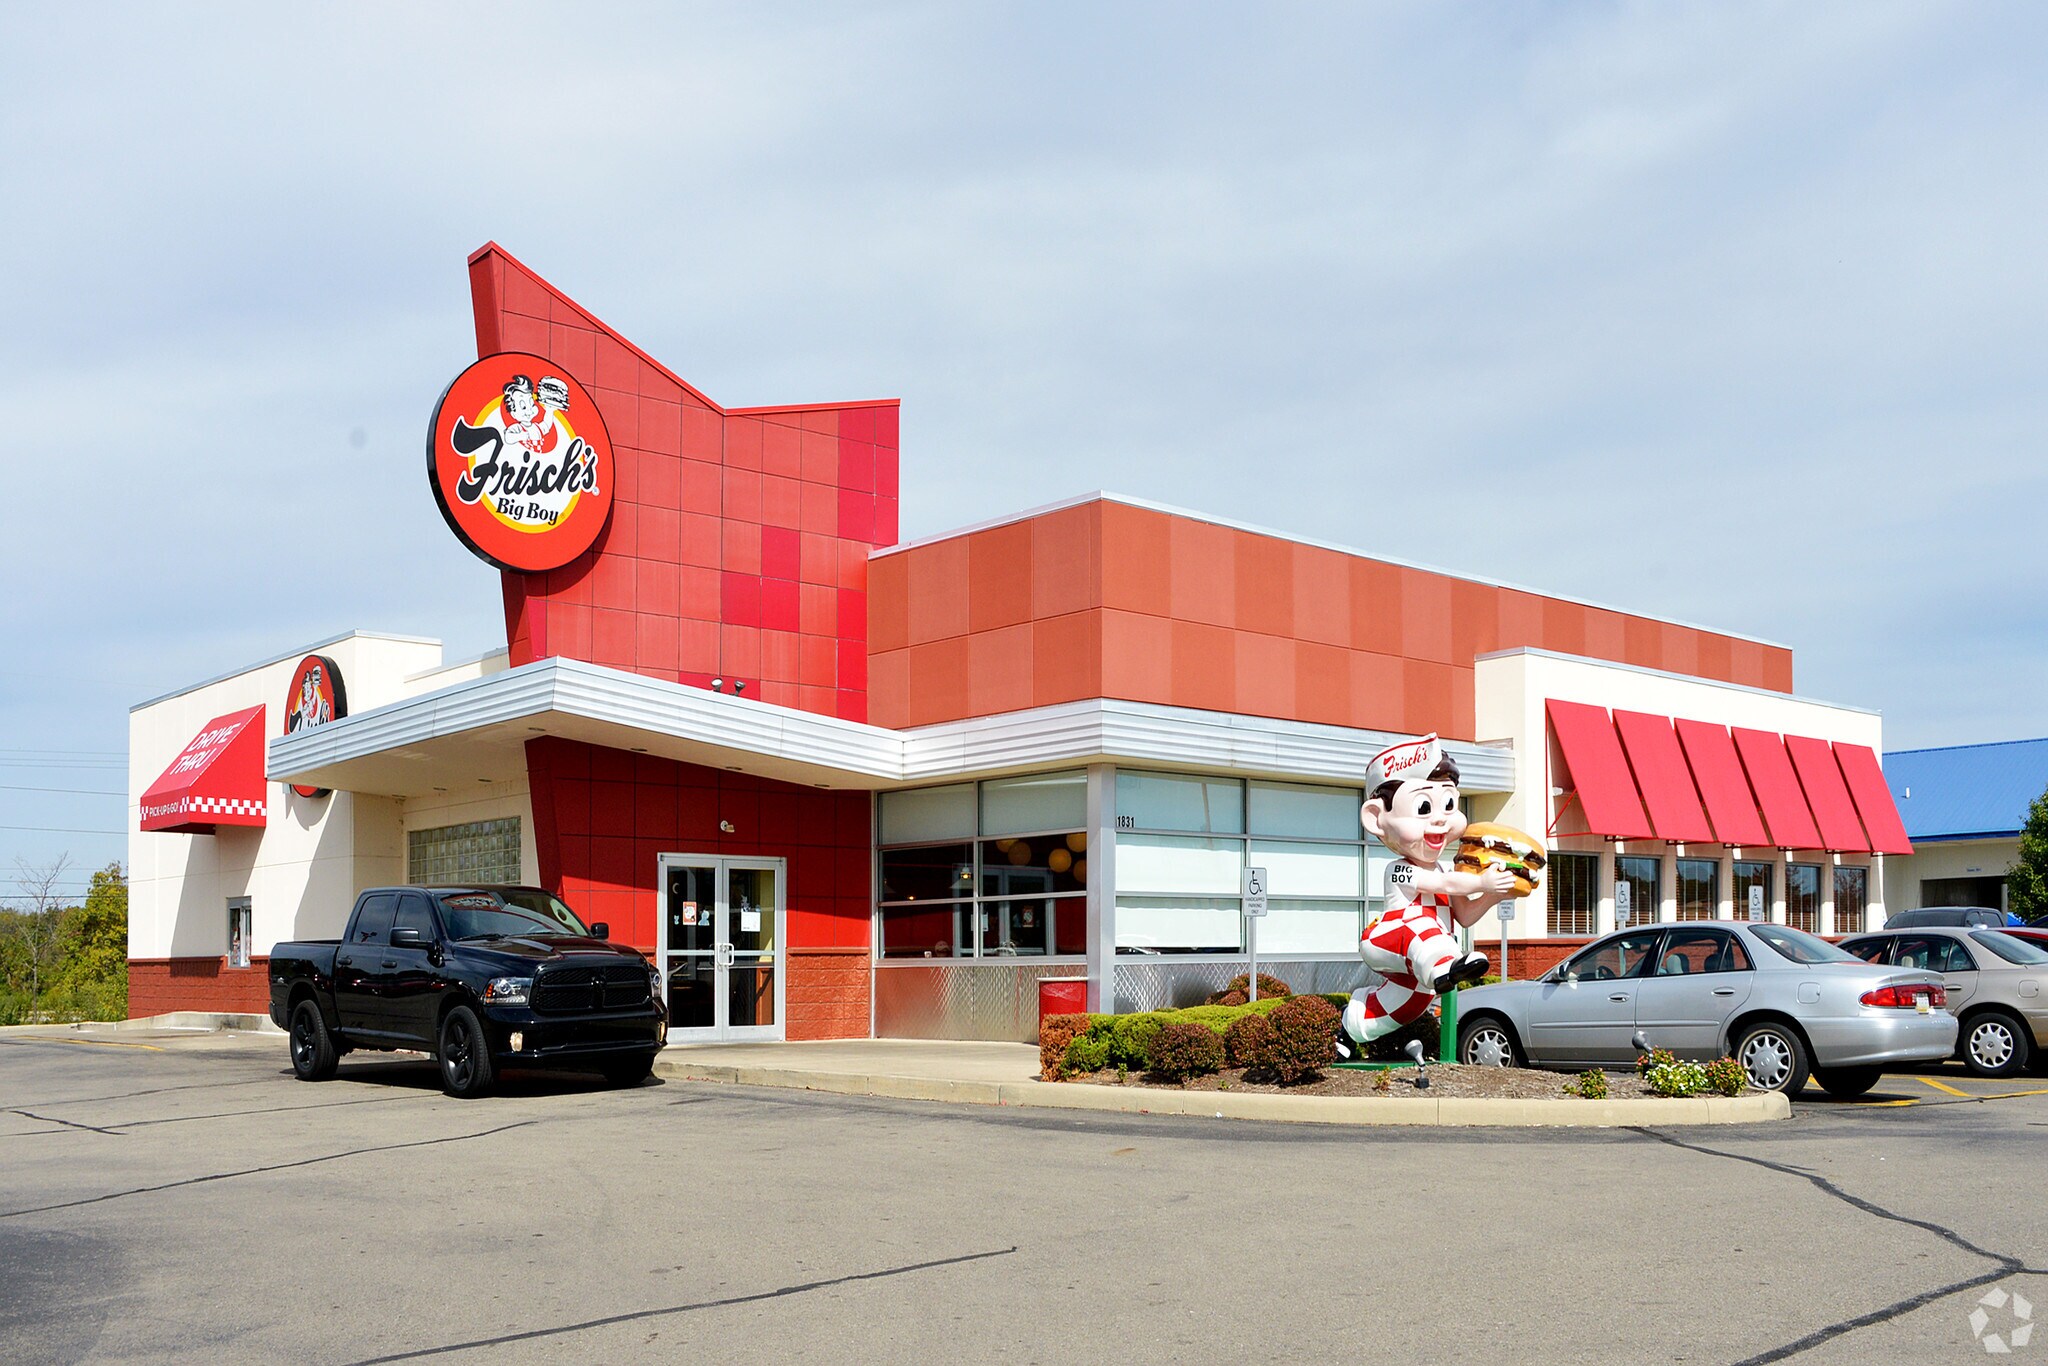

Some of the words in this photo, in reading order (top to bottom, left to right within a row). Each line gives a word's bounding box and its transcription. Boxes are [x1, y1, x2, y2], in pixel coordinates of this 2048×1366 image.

[453, 417, 596, 502] Frisch's
[496, 497, 524, 520] Big
[526, 502, 559, 526] Boy
[186, 722, 241, 752] DRIVE
[169, 747, 217, 775] THRU
[1383, 745, 1427, 778] Frisch's
[1117, 815, 1135, 828] 1831
[1391, 873, 1413, 883] BOY
[1394, 864, 1413, 873] BIG
